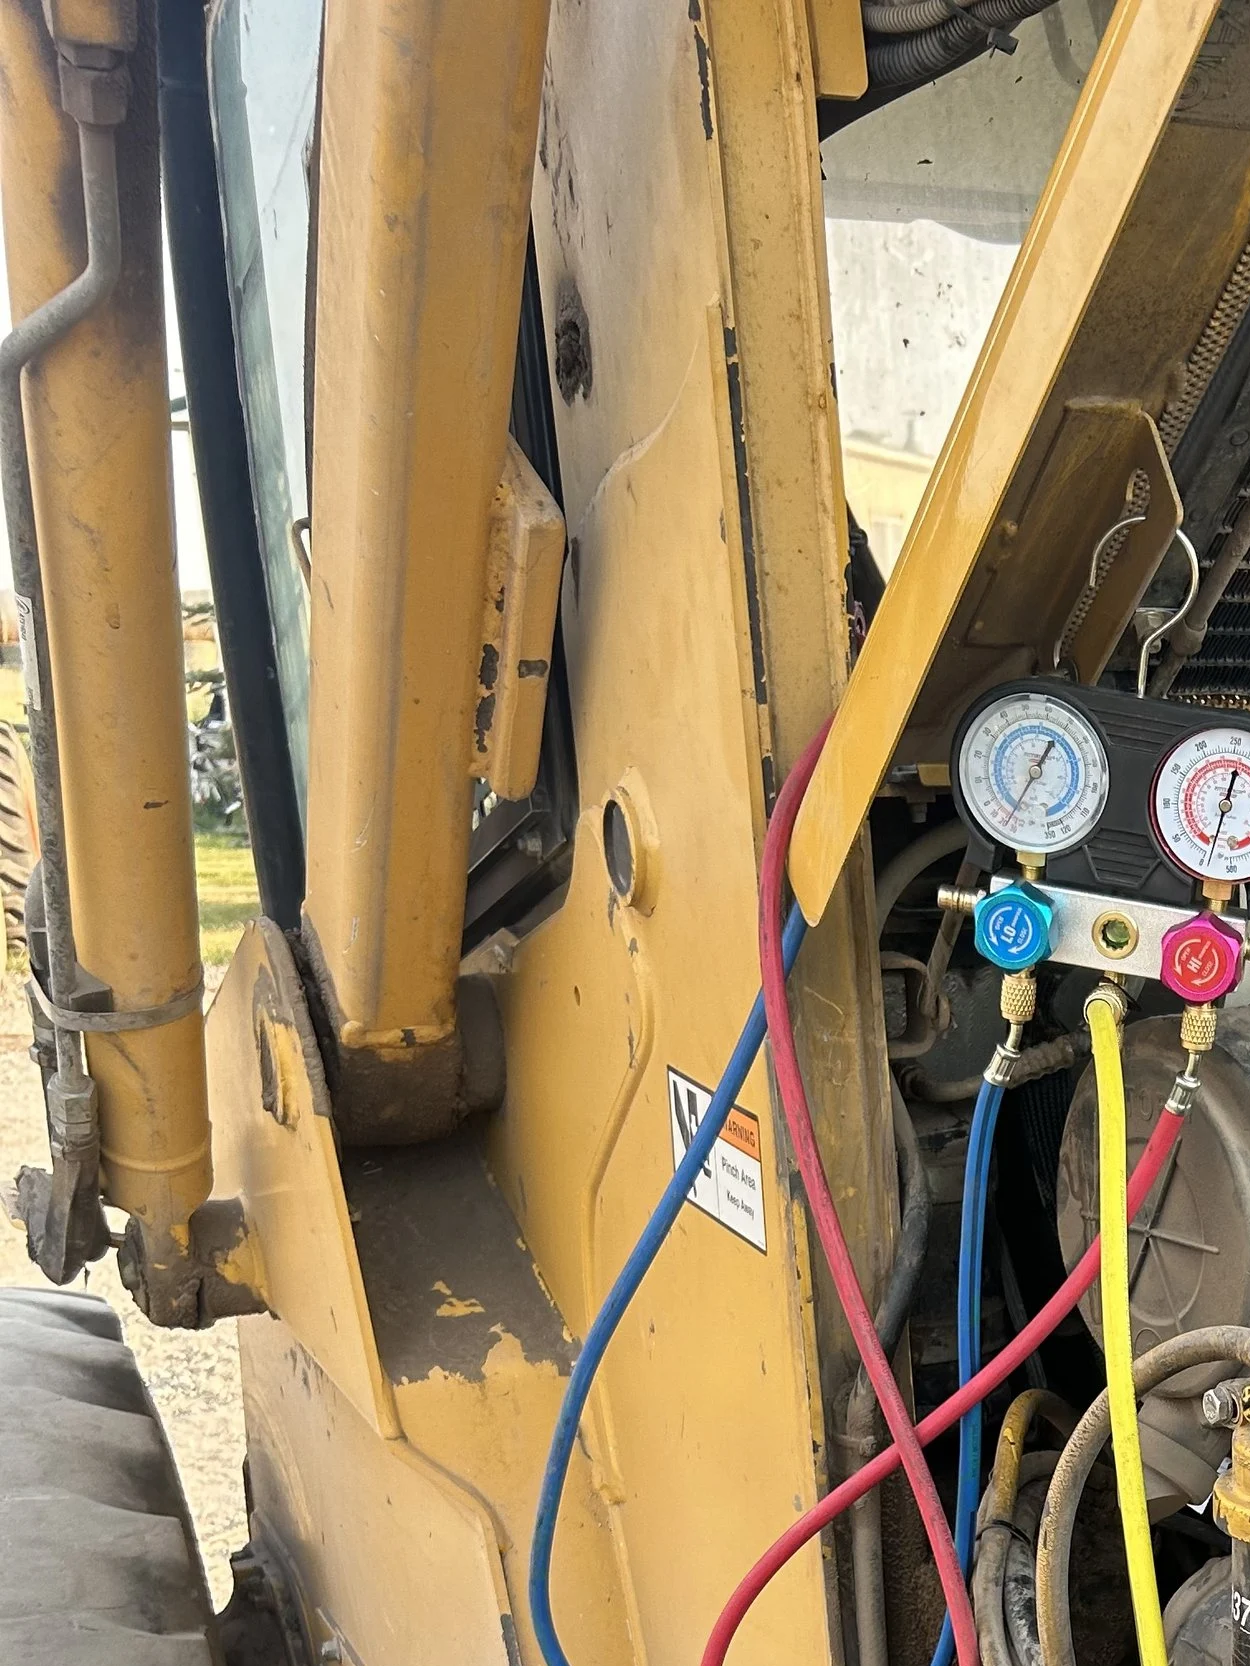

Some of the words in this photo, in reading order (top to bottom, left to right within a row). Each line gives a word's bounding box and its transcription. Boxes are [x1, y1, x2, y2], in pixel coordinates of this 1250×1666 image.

[1000, 711, 1008, 719] 40
[983, 727, 992, 736] 30
[1195, 740, 1207, 751] 200
[1230, 737, 1242, 746] 250
[974, 750, 982, 759] 20
[1171, 764, 1181, 775] 150
[1163, 798, 1171, 810] 100
[990, 810, 998, 818] 10
[1080, 808, 1090, 818] 110
[999, 818, 1008, 826] 20
[1061, 826, 1072, 835] 120
[1172, 834, 1181, 843] 50
[1199, 858, 1204, 866] 0
[1226, 865, 1237, 873] 500
[995, 916, 1004, 930] OPEN
[1000, 926, 1016, 944] LO
[1017, 927, 1027, 944] CLOSE
[1181, 947, 1191, 961] OPEN
[1187, 956, 1202, 973] HI
[1202, 961, 1213, 976] CLOSE
[722, 1156, 740, 1182] Pinch
[740, 1168, 756, 1190] Area
[726, 1190, 740, 1210] Keep
[740, 1202, 754, 1221] Away
